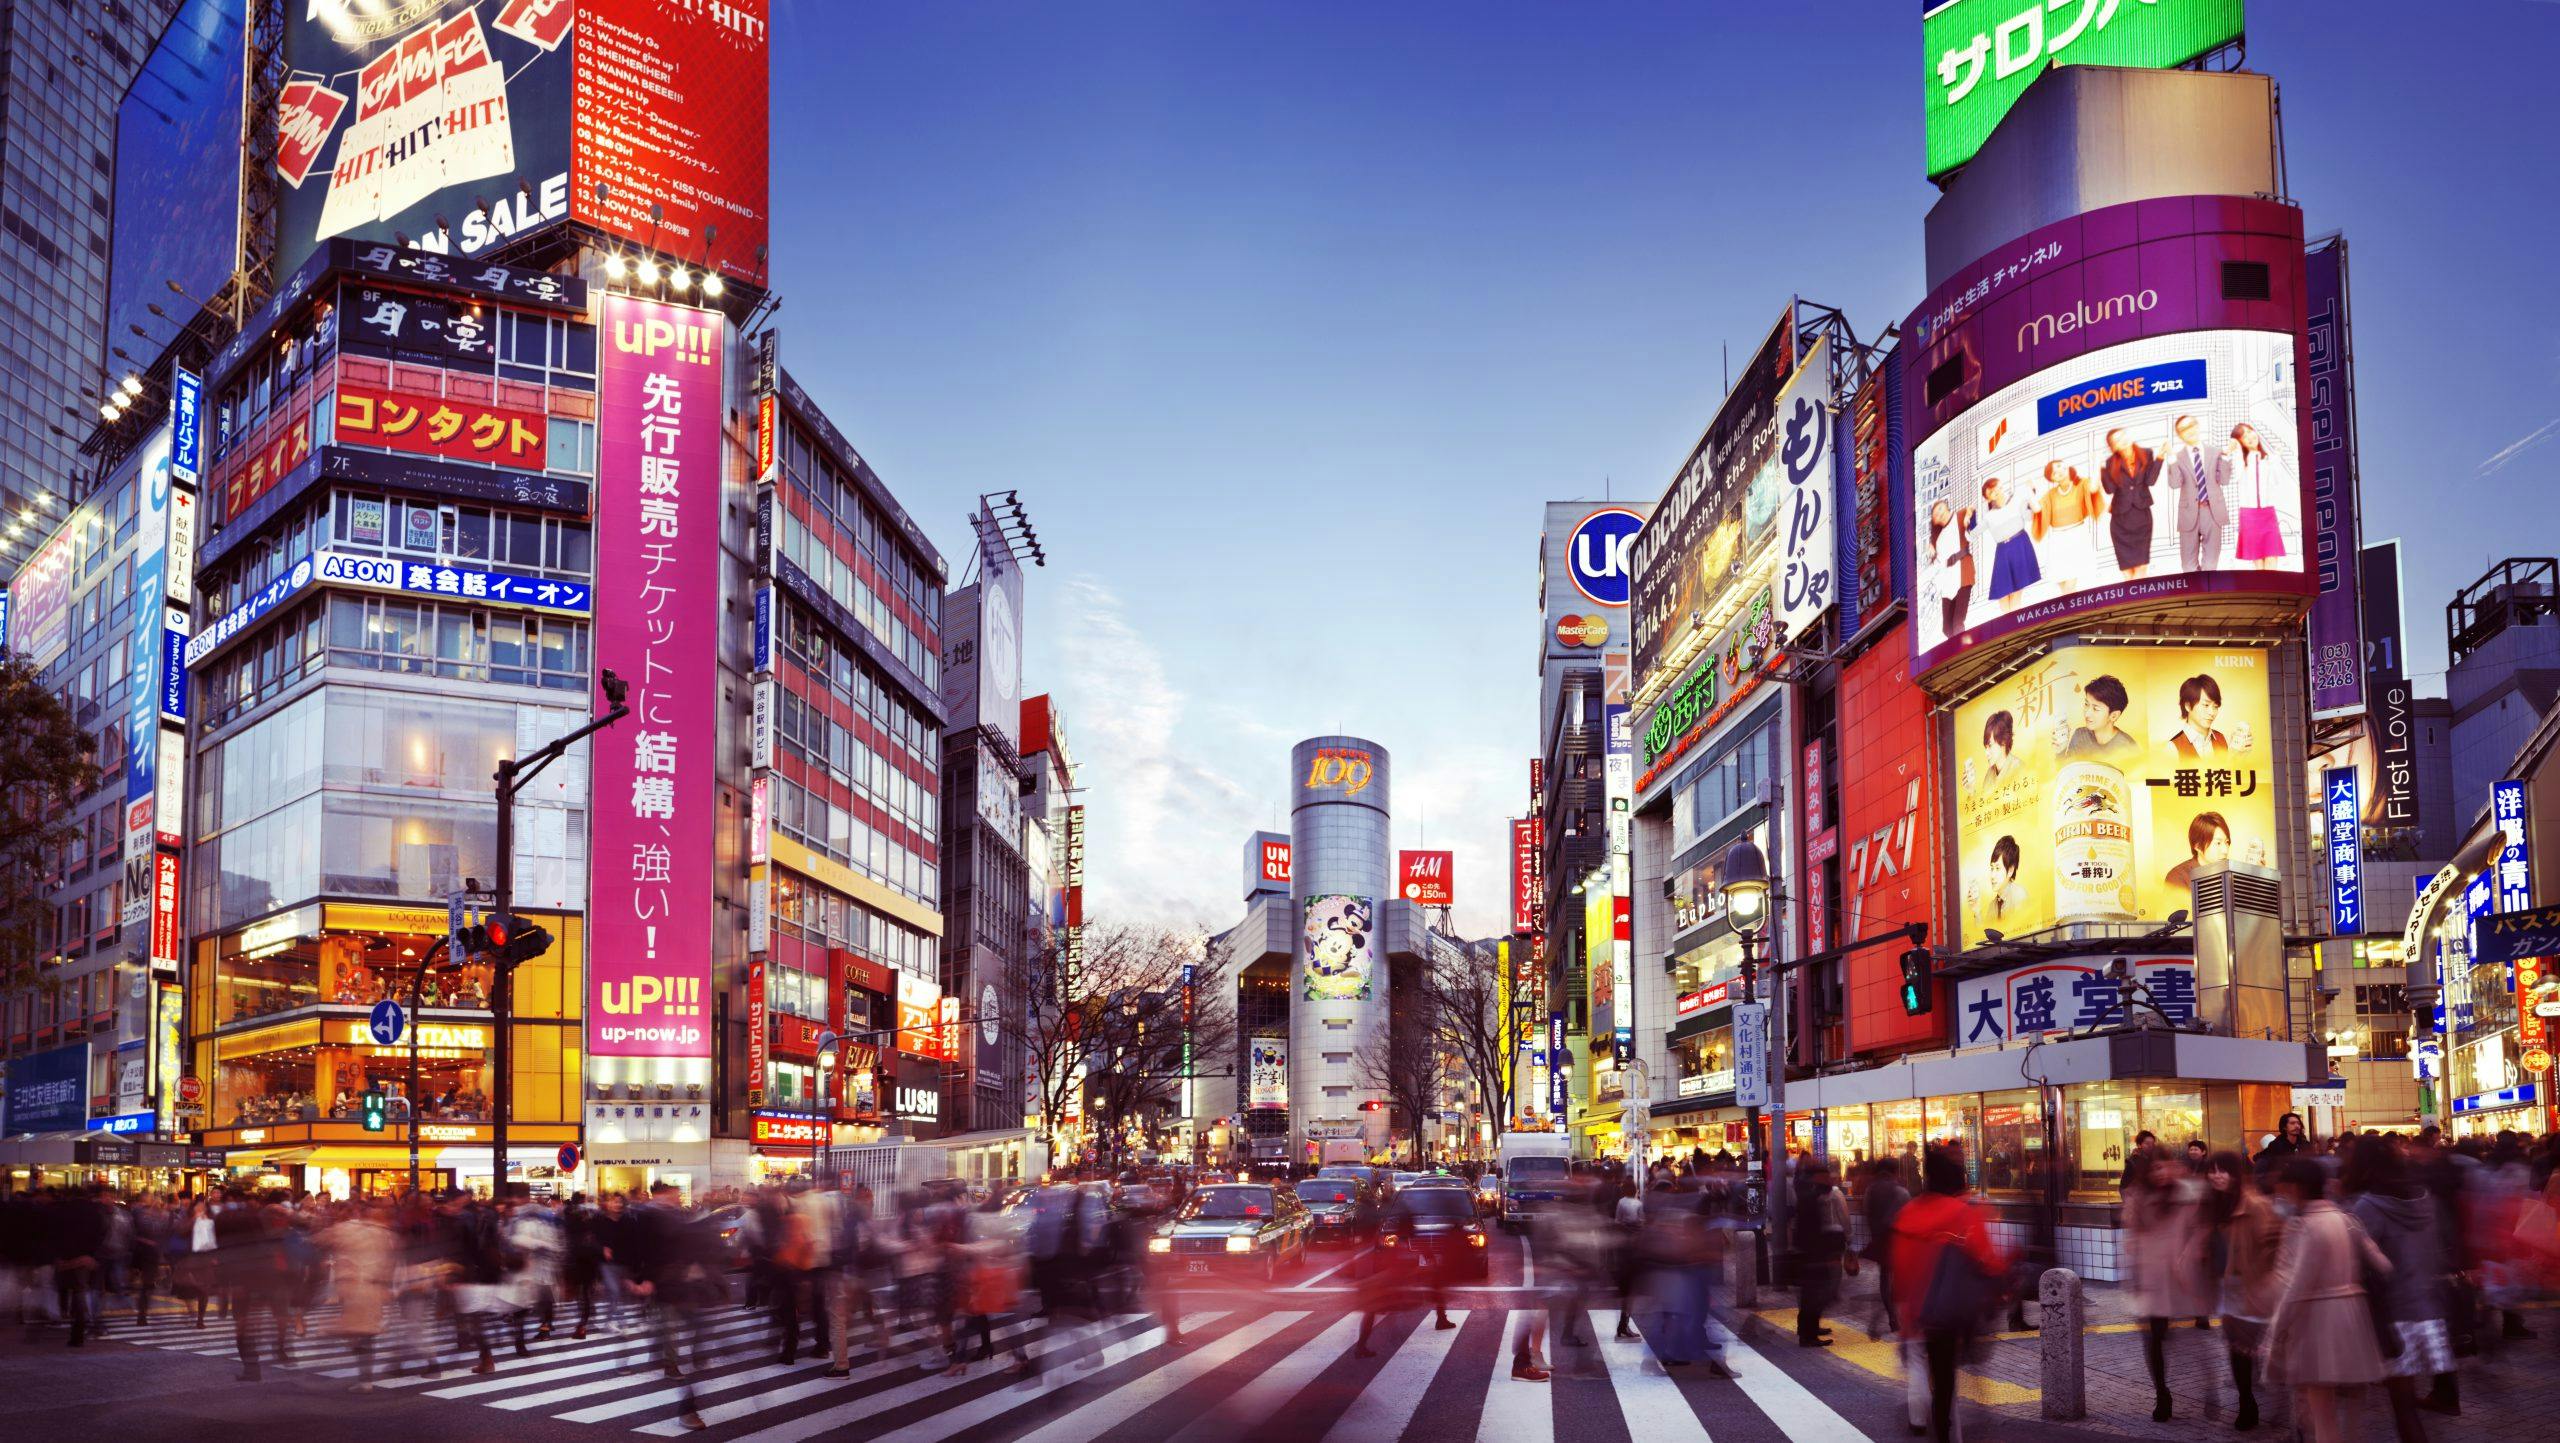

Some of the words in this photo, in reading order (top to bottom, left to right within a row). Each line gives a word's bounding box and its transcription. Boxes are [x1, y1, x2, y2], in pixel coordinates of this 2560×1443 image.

[578, 8, 595, 24] 01.
[597, 15, 645, 44] Everybody
[645, 36, 660, 50] Go
[578, 38, 595, 53] 03.
[578, 23, 595, 38] 02.
[597, 31, 614, 46] We
[615, 39, 642, 57] never
[642, 50, 661, 65] give
[662, 61, 674, 73] up
[578, 53, 595, 67] 04.
[597, 60, 639, 86] WANNA
[578, 67, 595, 82] 05.
[596, 75, 625, 95] Shake
[626, 84, 634, 97] It
[635, 90, 650, 105] Up
[443, 95, 507, 135] HIT!
[577, 97, 595, 112] 07.
[596, 105, 644, 130] アイノビート
[578, 82, 595, 97] 06.
[596, 90, 644, 116] アイノビート
[385, 116, 443, 168] HIT!
[577, 112, 594, 127] 08.
[596, 120, 611, 135] My
[613, 123, 661, 153] Resistance
[577, 127, 594, 143] 09.
[334, 142, 384, 189] HIT!
[577, 173, 594, 187] 12.
[577, 143, 595, 157] 10.
[672, 179, 695, 197] KISS
[696, 187, 726, 208] YOUR
[726, 201, 754, 218] MIND
[577, 158, 594, 172] 11.
[595, 165, 622, 183] S.O.S
[624, 171, 653, 195] (Smile
[654, 187, 670, 201] On
[670, 191, 699, 213] Smile)
[577, 188, 594, 202] 13.
[460, 172, 568, 253] SALE
[577, 202, 593, 218] 14.
[594, 210, 612, 224] Luv
[613, 216, 633, 233] Sick
[363, 291, 381, 302] 9F
[1932, 276, 1990, 332] わかさ生活
[1994, 240, 2063, 289] チャンネル
[2018, 289, 2158, 353] melumo
[615, 317, 711, 366] uP!!!
[2058, 377, 2146, 418] PROMISE
[2151, 378, 2184, 394] プロミス
[339, 394, 541, 455] コンタクト
[229, 419, 309, 515] プライス
[332, 456, 350, 471] 7F
[405, 469, 437, 480] MODERN
[439, 473, 476, 486] JAPANESE
[478, 479, 506, 490] DINING
[1634, 442, 1714, 584] OLDCODEX
[1717, 437, 1735, 468] NEW
[1732, 402, 1758, 445] ALBUM
[1684, 490, 1721, 547] within
[1725, 456, 1747, 490] the
[1782, 397, 1830, 612] もんじゃ
[355, 511, 381, 521] スタッフ
[174, 516, 190, 587] 献血ルーム
[324, 556, 393, 583] AEON
[408, 565, 584, 607] 英会話イーオン
[2016, 603, 2066, 624] WAKASA
[2070, 588, 2125, 609] SEIKATSU
[2129, 579, 2189, 596] CHANNEL
[217, 579, 290, 643] 英会話イーオン
[1557, 622, 1610, 639] MasterCard
[1635, 582, 1677, 657] 2014.4.2
[187, 630, 213, 662] AEON
[2214, 655, 2256, 667] KIRIN
[2321, 642, 2350, 661] (03)
[133, 574, 158, 778] アイシティ
[2317, 673, 2354, 690] 2468
[2318, 658, 2353, 676] 3719
[1673, 669, 1717, 737] 西村
[2016, 661, 2079, 728] 新
[756, 689, 766, 761] 渋谷駅前ビル
[2385, 687, 2408, 754] Love
[754, 778, 766, 789] 5F
[1305, 756, 1373, 796] 109
[1808, 748, 1820, 833] お好み焼
[2146, 768, 2257, 798] 一番搾り
[2386, 759, 2411, 820] First
[162, 833, 175, 843] 4F
[2056, 824, 2093, 843] KIRIN
[2097, 823, 2130, 839] BEER
[2331, 779, 2359, 925] 大盛堂商事ビル
[2497, 787, 2529, 912] 洋服の青山
[1267, 846, 1288, 861] UN
[1410, 856, 1442, 878] H&M
[1850, 776, 1921, 944] クスリ
[1516, 823, 1532, 928] Essential
[2070, 868, 2113, 879] 一番搾り
[1422, 890, 1447, 899] 150m
[2405, 868, 2452, 960] 渋谷センター街
[844, 964, 870, 985] COFFEE
[601, 975, 700, 1016] uP!!!
[601, 1025, 700, 1045] up-now.jp
[751, 1000, 763, 1085] サンドラッグ
[802, 1026, 811, 1042] 薬
[1738, 1012, 1755, 1091] 文化村通り
[2520, 1037, 2545, 1045] ナポリス
[14, 1077, 77, 1110] 三井住友信託銀行
[1253, 1068, 1285, 1087] 学割
[595, 1107, 701, 1118] 渋谷駅前ビル
[750, 1091, 762, 1107] 薬
[896, 1086, 938, 1115] LUSH
[1739, 1094, 1756, 1102] 方面
[593, 1158, 626, 1166] SHIBUYA
[630, 1158, 660, 1166] EKIMAE
